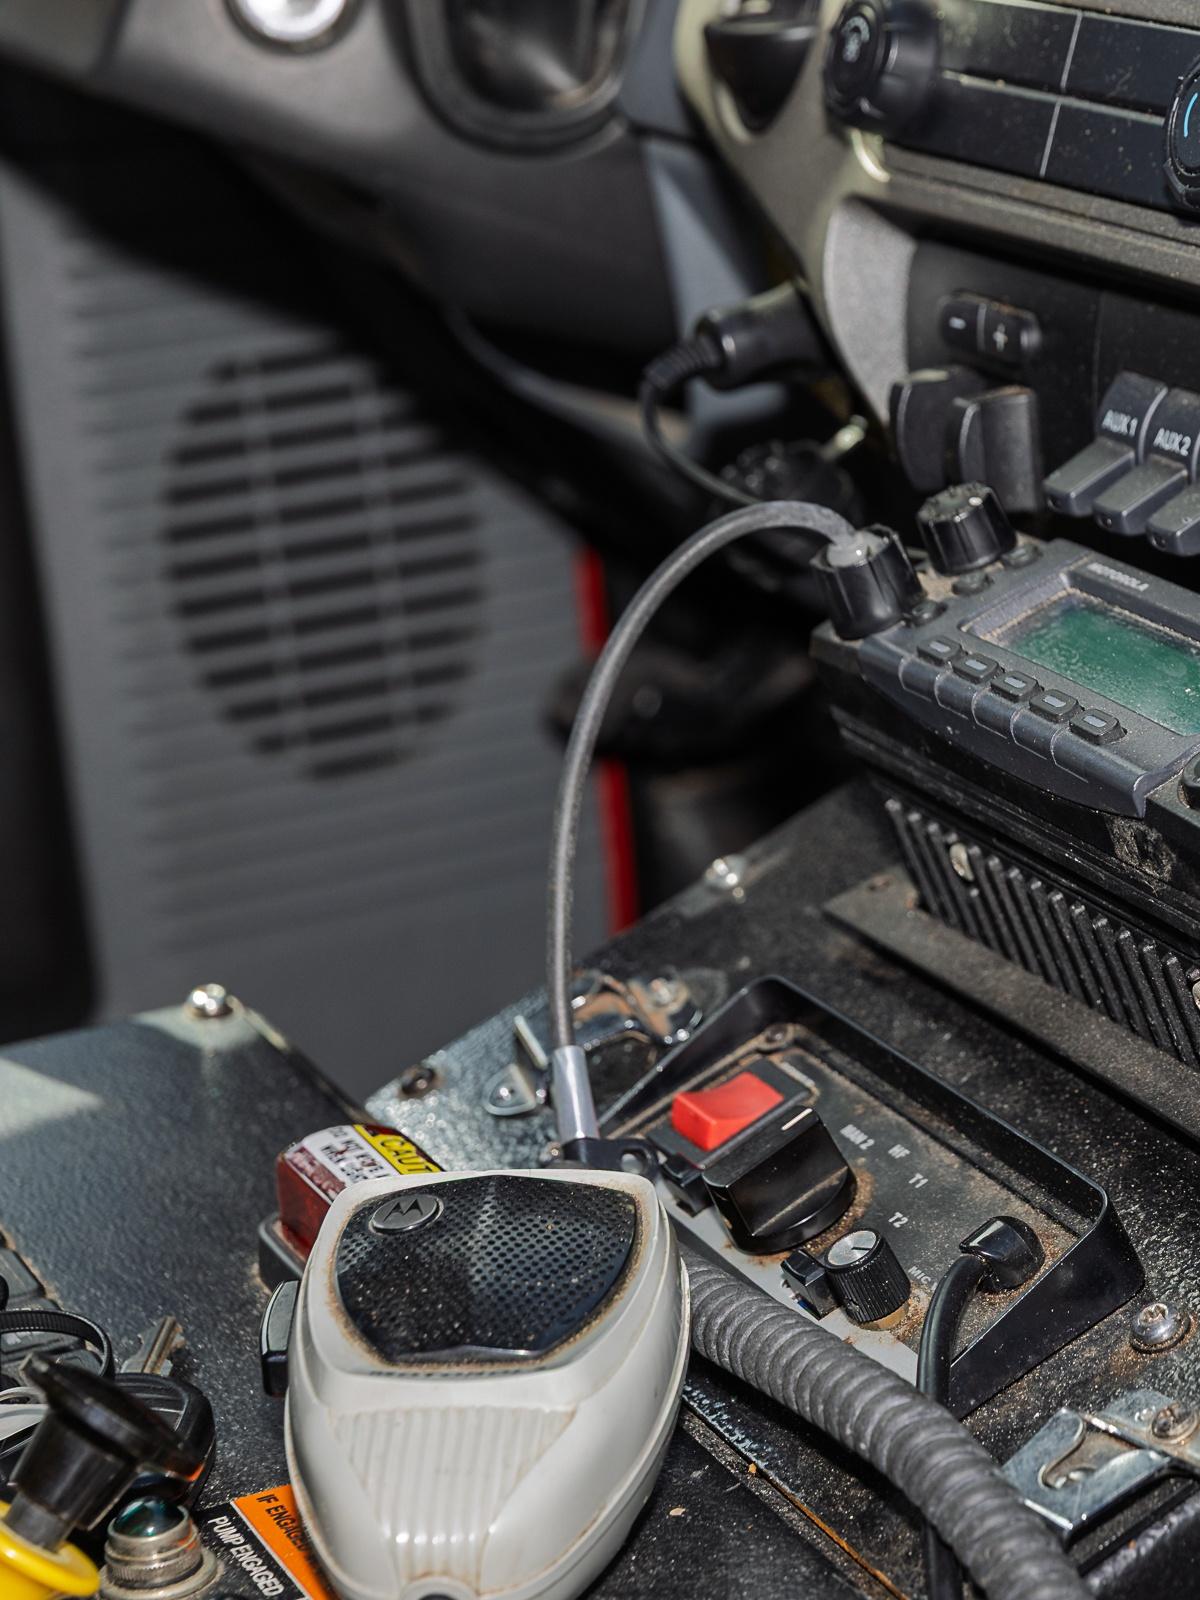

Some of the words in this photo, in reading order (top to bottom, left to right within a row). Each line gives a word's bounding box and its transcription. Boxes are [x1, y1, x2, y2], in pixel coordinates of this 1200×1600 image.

[888, 1211, 909, 1228] T2
[908, 1265, 931, 1284] MIC
[256, 1493, 279, 1503] IF
[207, 1515, 246, 1546] PUMP
[230, 1543, 285, 1597] ENGAGED
